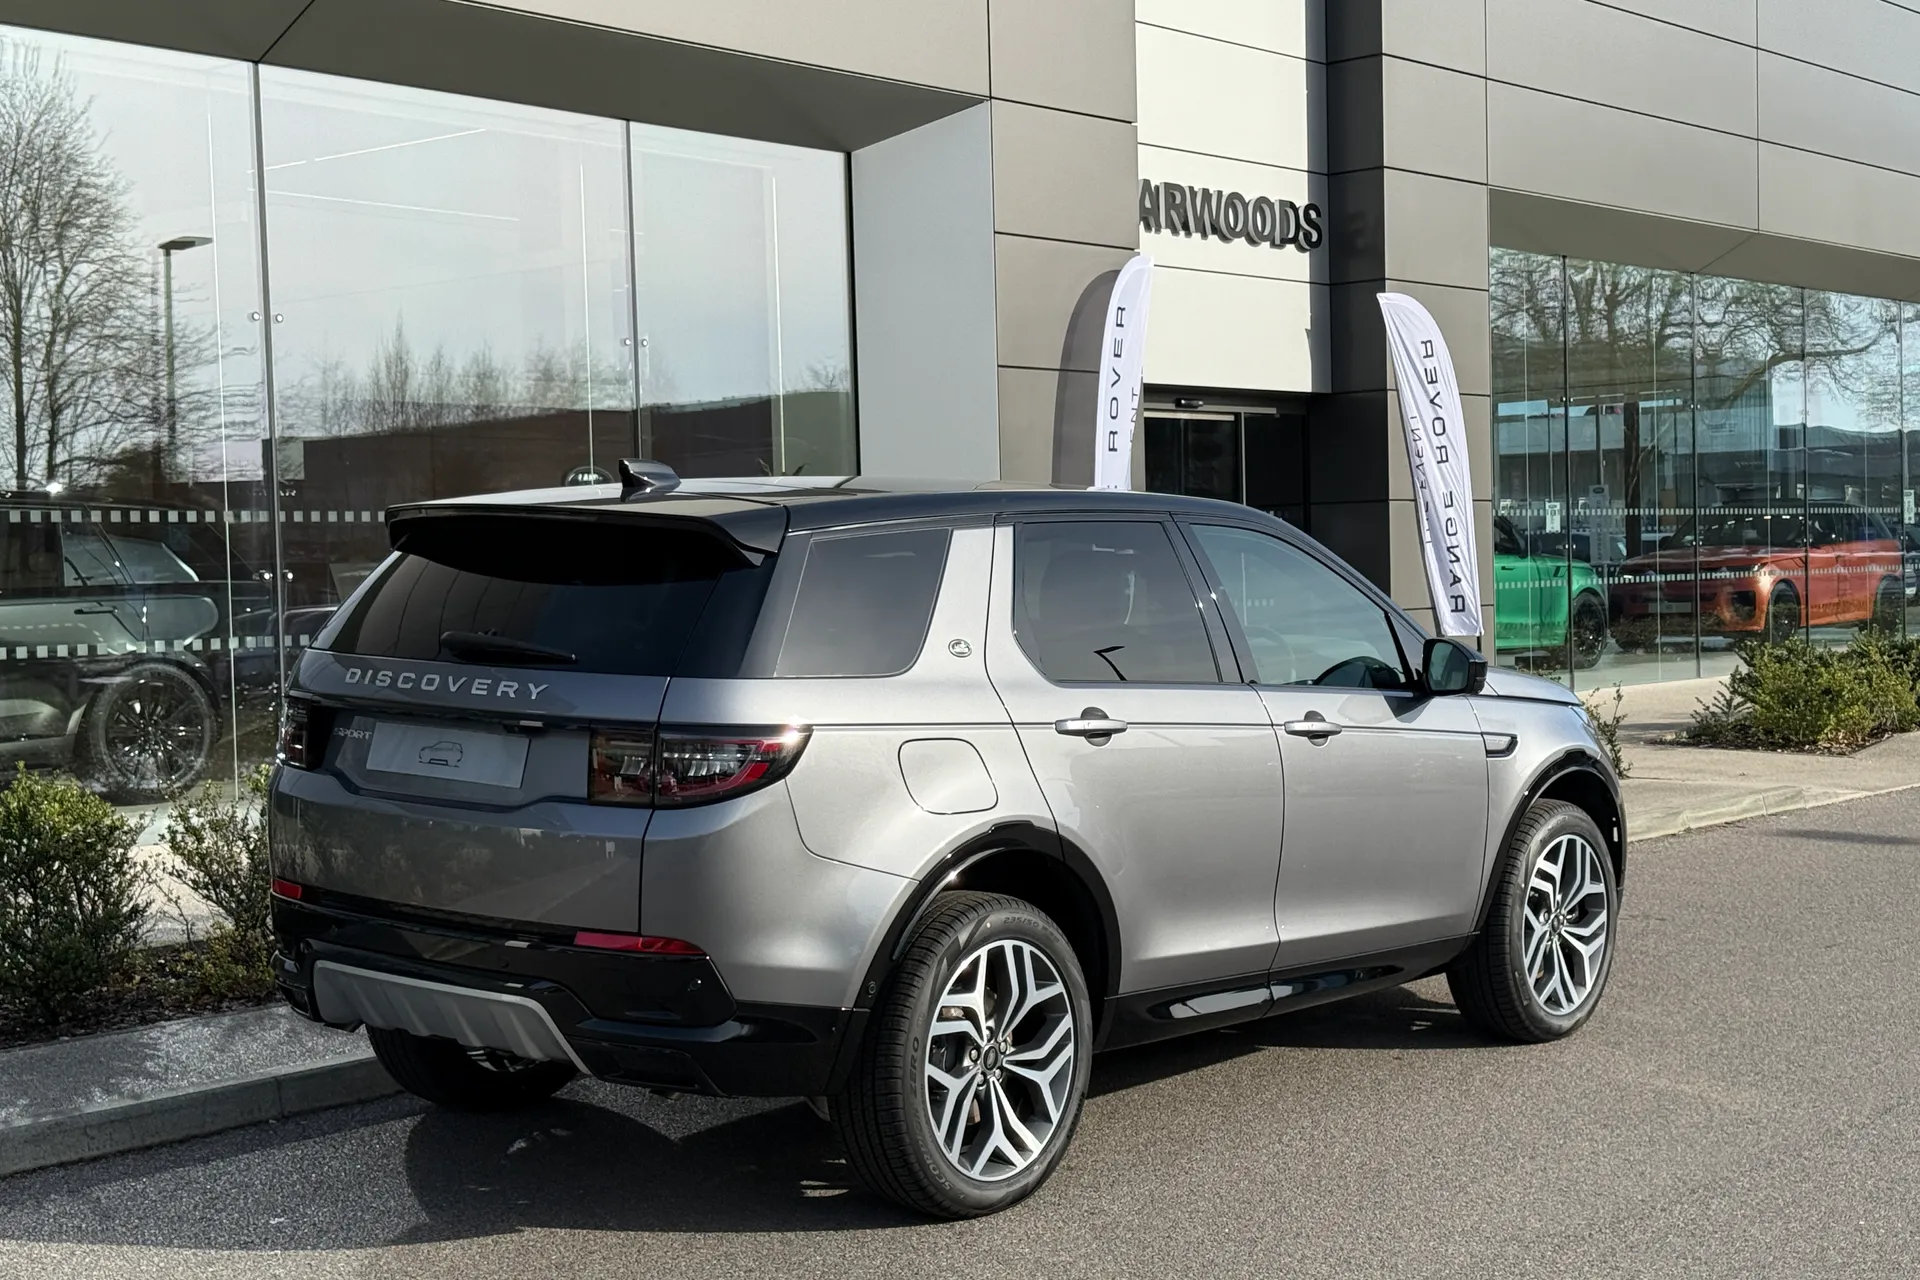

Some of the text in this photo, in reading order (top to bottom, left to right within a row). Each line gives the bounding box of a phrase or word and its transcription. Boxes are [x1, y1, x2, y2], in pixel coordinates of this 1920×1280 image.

[1108, 306, 1126, 452] ROVER
[345, 668, 549, 700] DISCOVERY
[333, 727, 373, 740] SPORT
